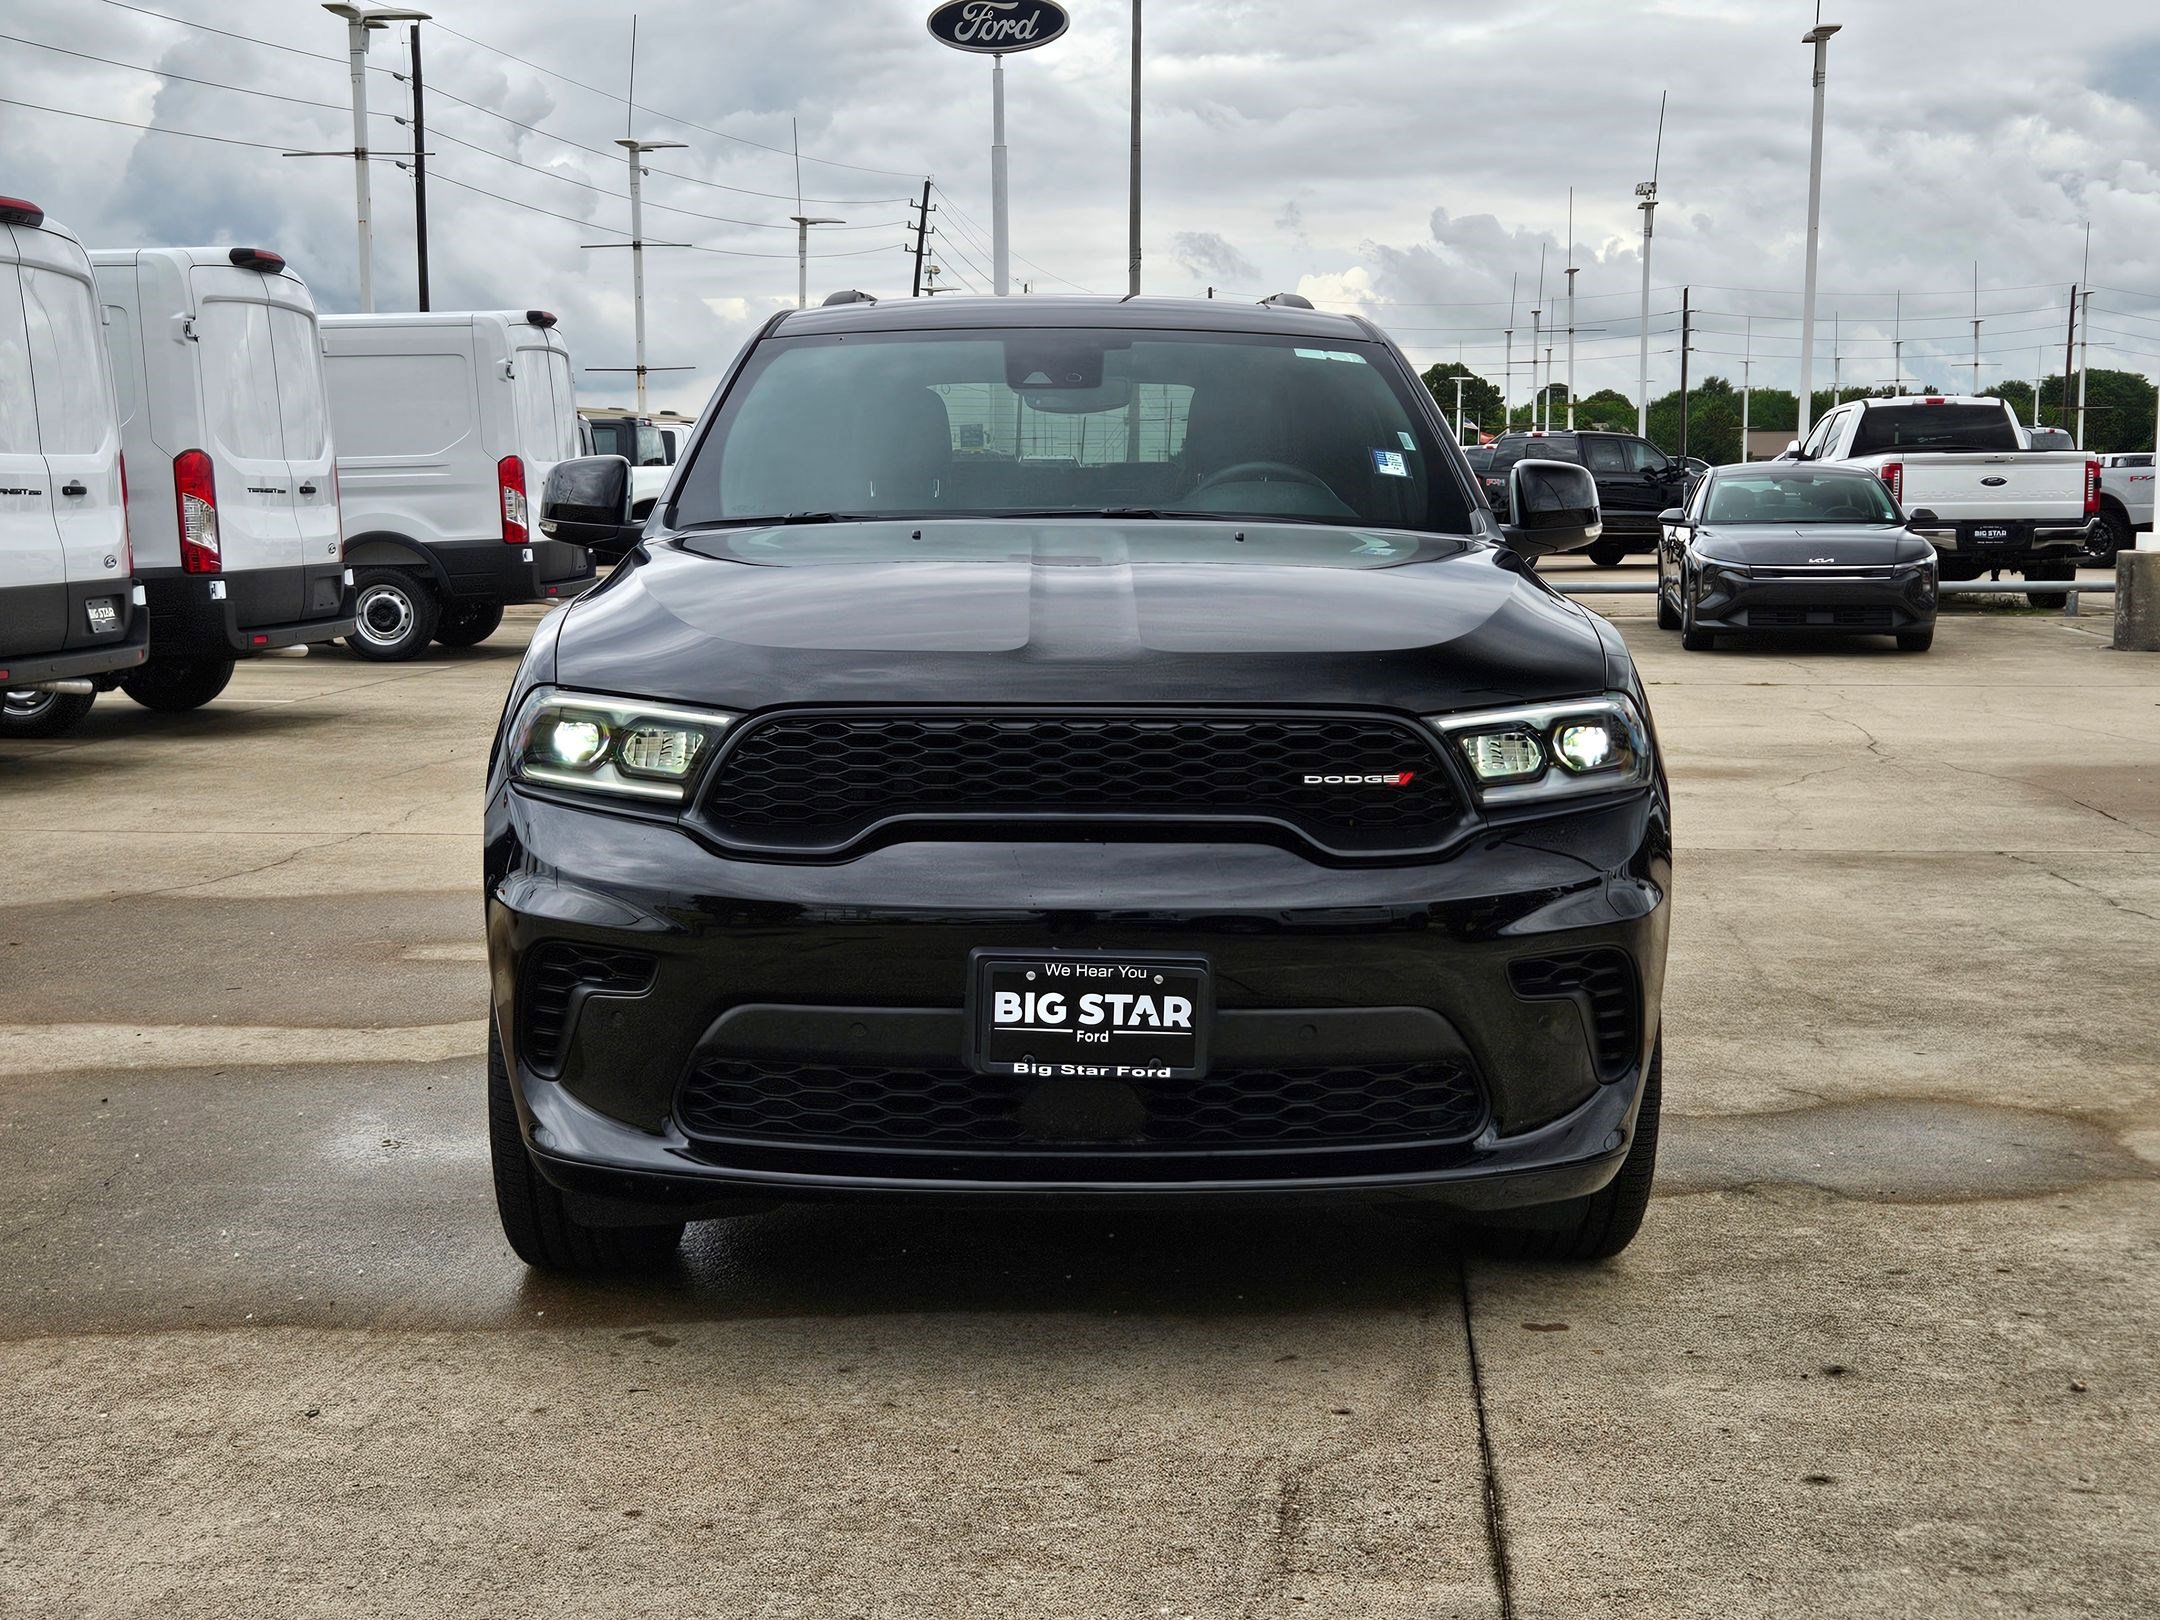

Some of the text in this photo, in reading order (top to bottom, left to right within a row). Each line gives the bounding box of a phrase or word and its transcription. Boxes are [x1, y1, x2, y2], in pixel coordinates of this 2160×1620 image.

[954, 1, 1040, 41] Ford
[1913, 489, 2076, 499] SUPER DUTY
[98, 607, 115, 618] STAR
[1304, 775, 1400, 784] DODGE
[1045, 964, 1147, 979] We Hear You
[994, 991, 1192, 1028] BIG STAR
[1076, 1030, 1109, 1043] Ford
[1013, 1063, 1171, 1078] Big Star Ford
